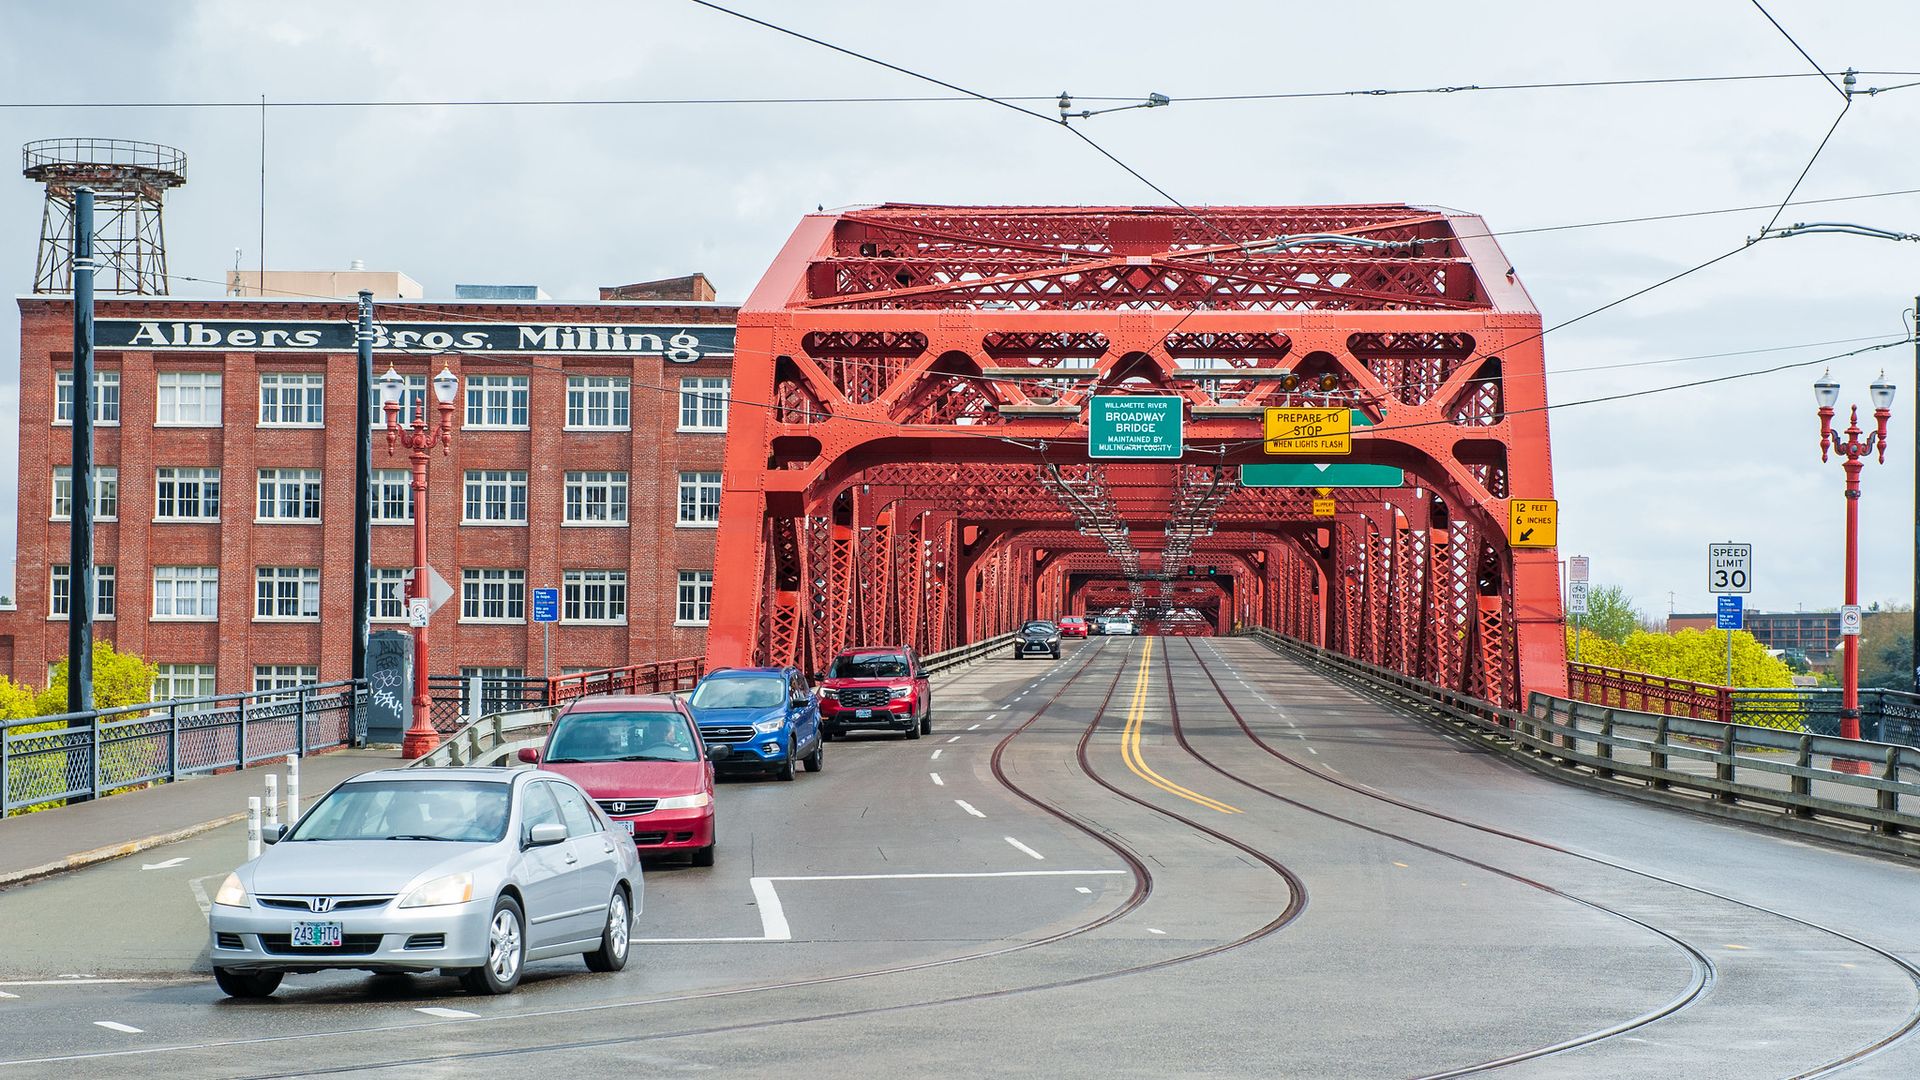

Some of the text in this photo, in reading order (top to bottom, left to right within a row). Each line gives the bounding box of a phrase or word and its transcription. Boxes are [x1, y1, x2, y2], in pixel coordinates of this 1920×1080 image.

[128, 322, 699, 363] Albers Bros. Milling
[1106, 412, 1166, 421] BROADWAY
[1277, 414, 1339, 422] PREPARE TO
[1116, 423, 1156, 432] BRIDGE
[1293, 426, 1322, 436] STOP
[1516, 503, 1526, 512] 12
[1516, 516, 1522, 525] 6
[1713, 549, 1748, 557] SPEED
[1714, 570, 1746, 588] 30
[294, 927, 313, 941] 243
